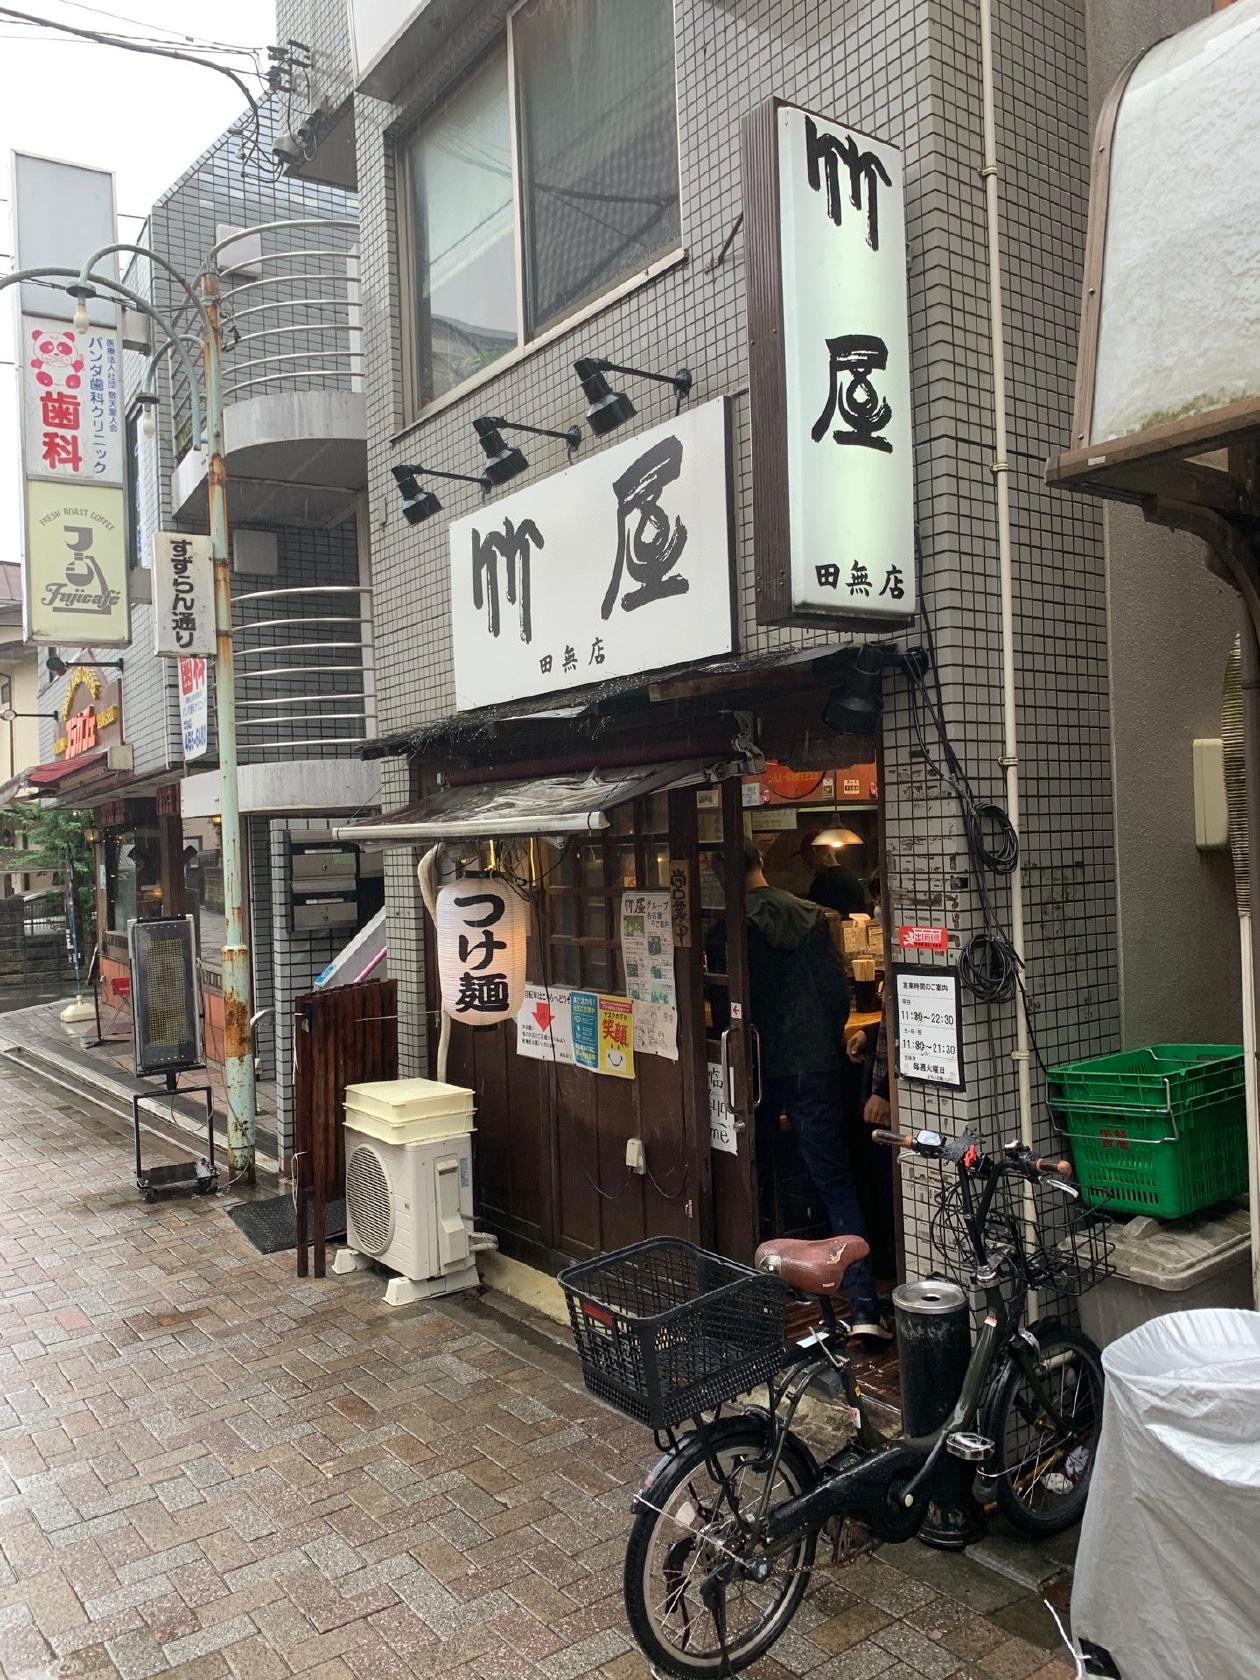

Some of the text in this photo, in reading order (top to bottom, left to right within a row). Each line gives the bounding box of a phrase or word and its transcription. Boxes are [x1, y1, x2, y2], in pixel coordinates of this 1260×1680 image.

[88, 336, 107, 474] パンダ歯科クリニック
[40, 391, 83, 472] 歯科
[38, 507, 116, 532] FRESH ROAST COFFEE
[170, 539, 196, 649] すずらん通り
[815, 559, 905, 600] 田無店
[539, 636, 606, 674] 田無店
[454, 893, 510, 1013] つけ麺
[903, 982, 949, 992] 営業時間のご案内
[602, 1018, 628, 1046] 笑顔
[913, 1062, 945, 1074] 毎週火曜日
